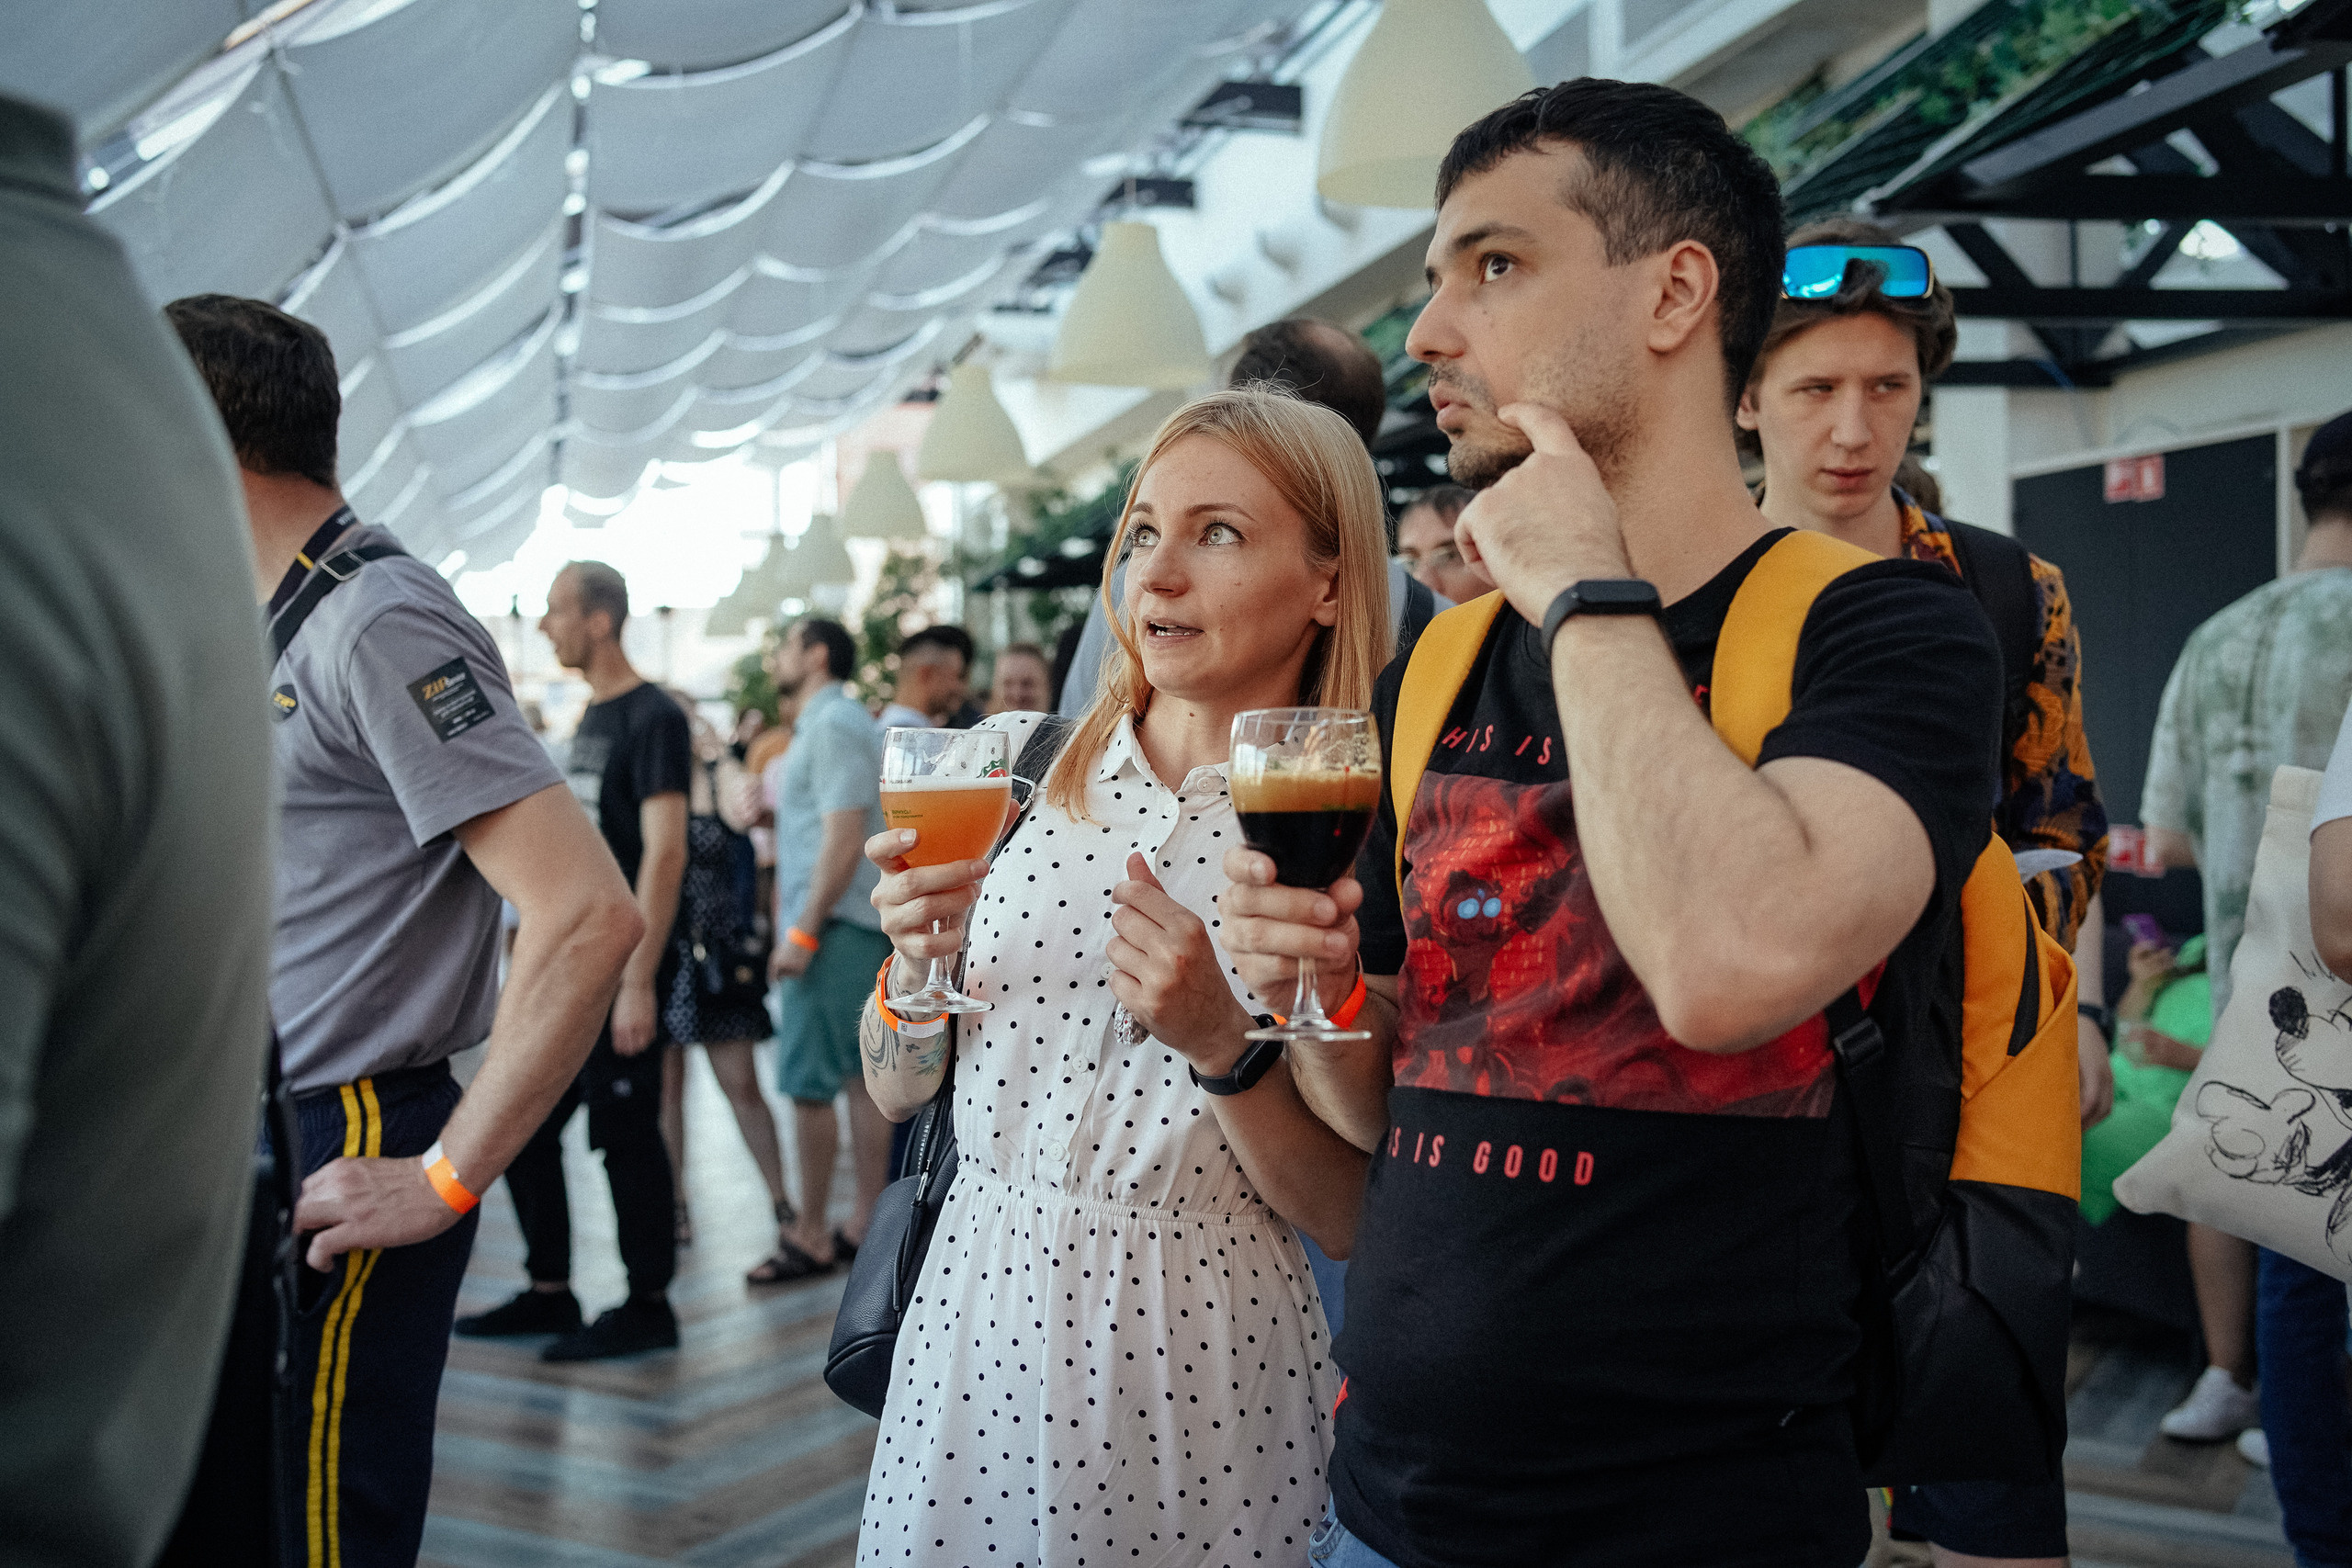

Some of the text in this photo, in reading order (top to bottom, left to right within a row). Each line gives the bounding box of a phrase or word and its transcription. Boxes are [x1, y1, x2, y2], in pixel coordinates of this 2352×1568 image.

[1442, 724, 1553, 765] HIS IS
[1413, 1132, 1445, 1168] IS
[1473, 1141, 1595, 1186] GOOD
